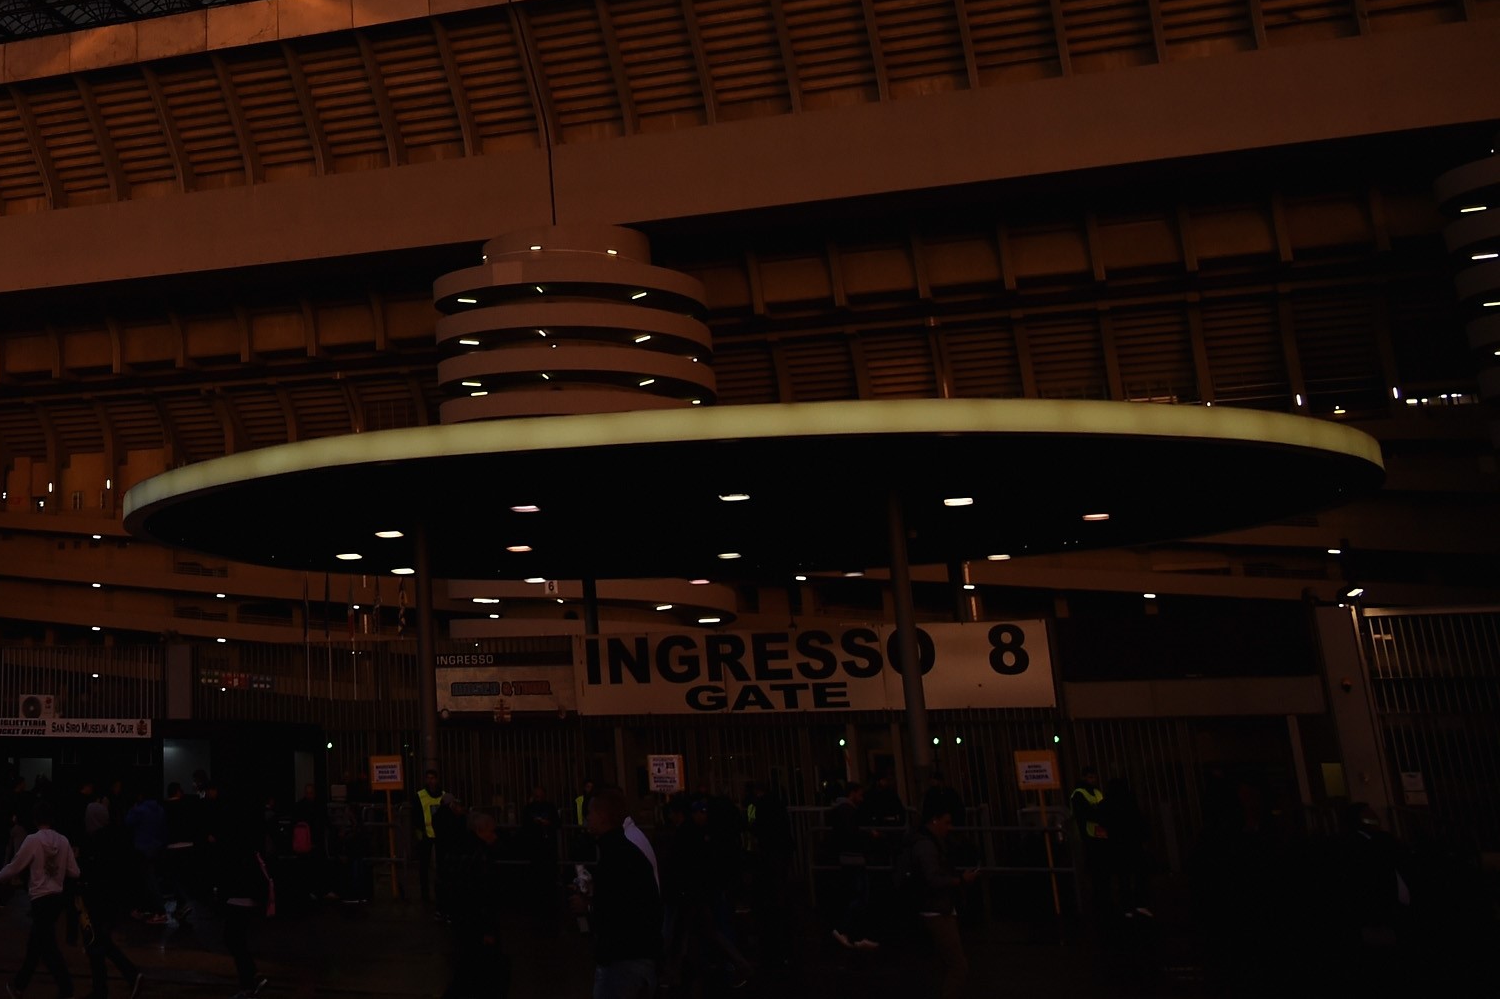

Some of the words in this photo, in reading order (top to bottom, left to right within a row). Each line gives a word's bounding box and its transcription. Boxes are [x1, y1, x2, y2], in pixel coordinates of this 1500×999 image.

[548, 581, 555, 592] 6
[436, 654, 494, 666] INGRESSO
[585, 627, 936, 685] INGRESSO
[988, 623, 1030, 675] 8
[685, 682, 850, 711] GATE
[21, 728, 47, 736] OFFICE
[52, 721, 65, 733] SAN
[65, 721, 81, 734] SIRO
[82, 722, 109, 734] MUSEUM
[117, 722, 135, 734] TOUR
